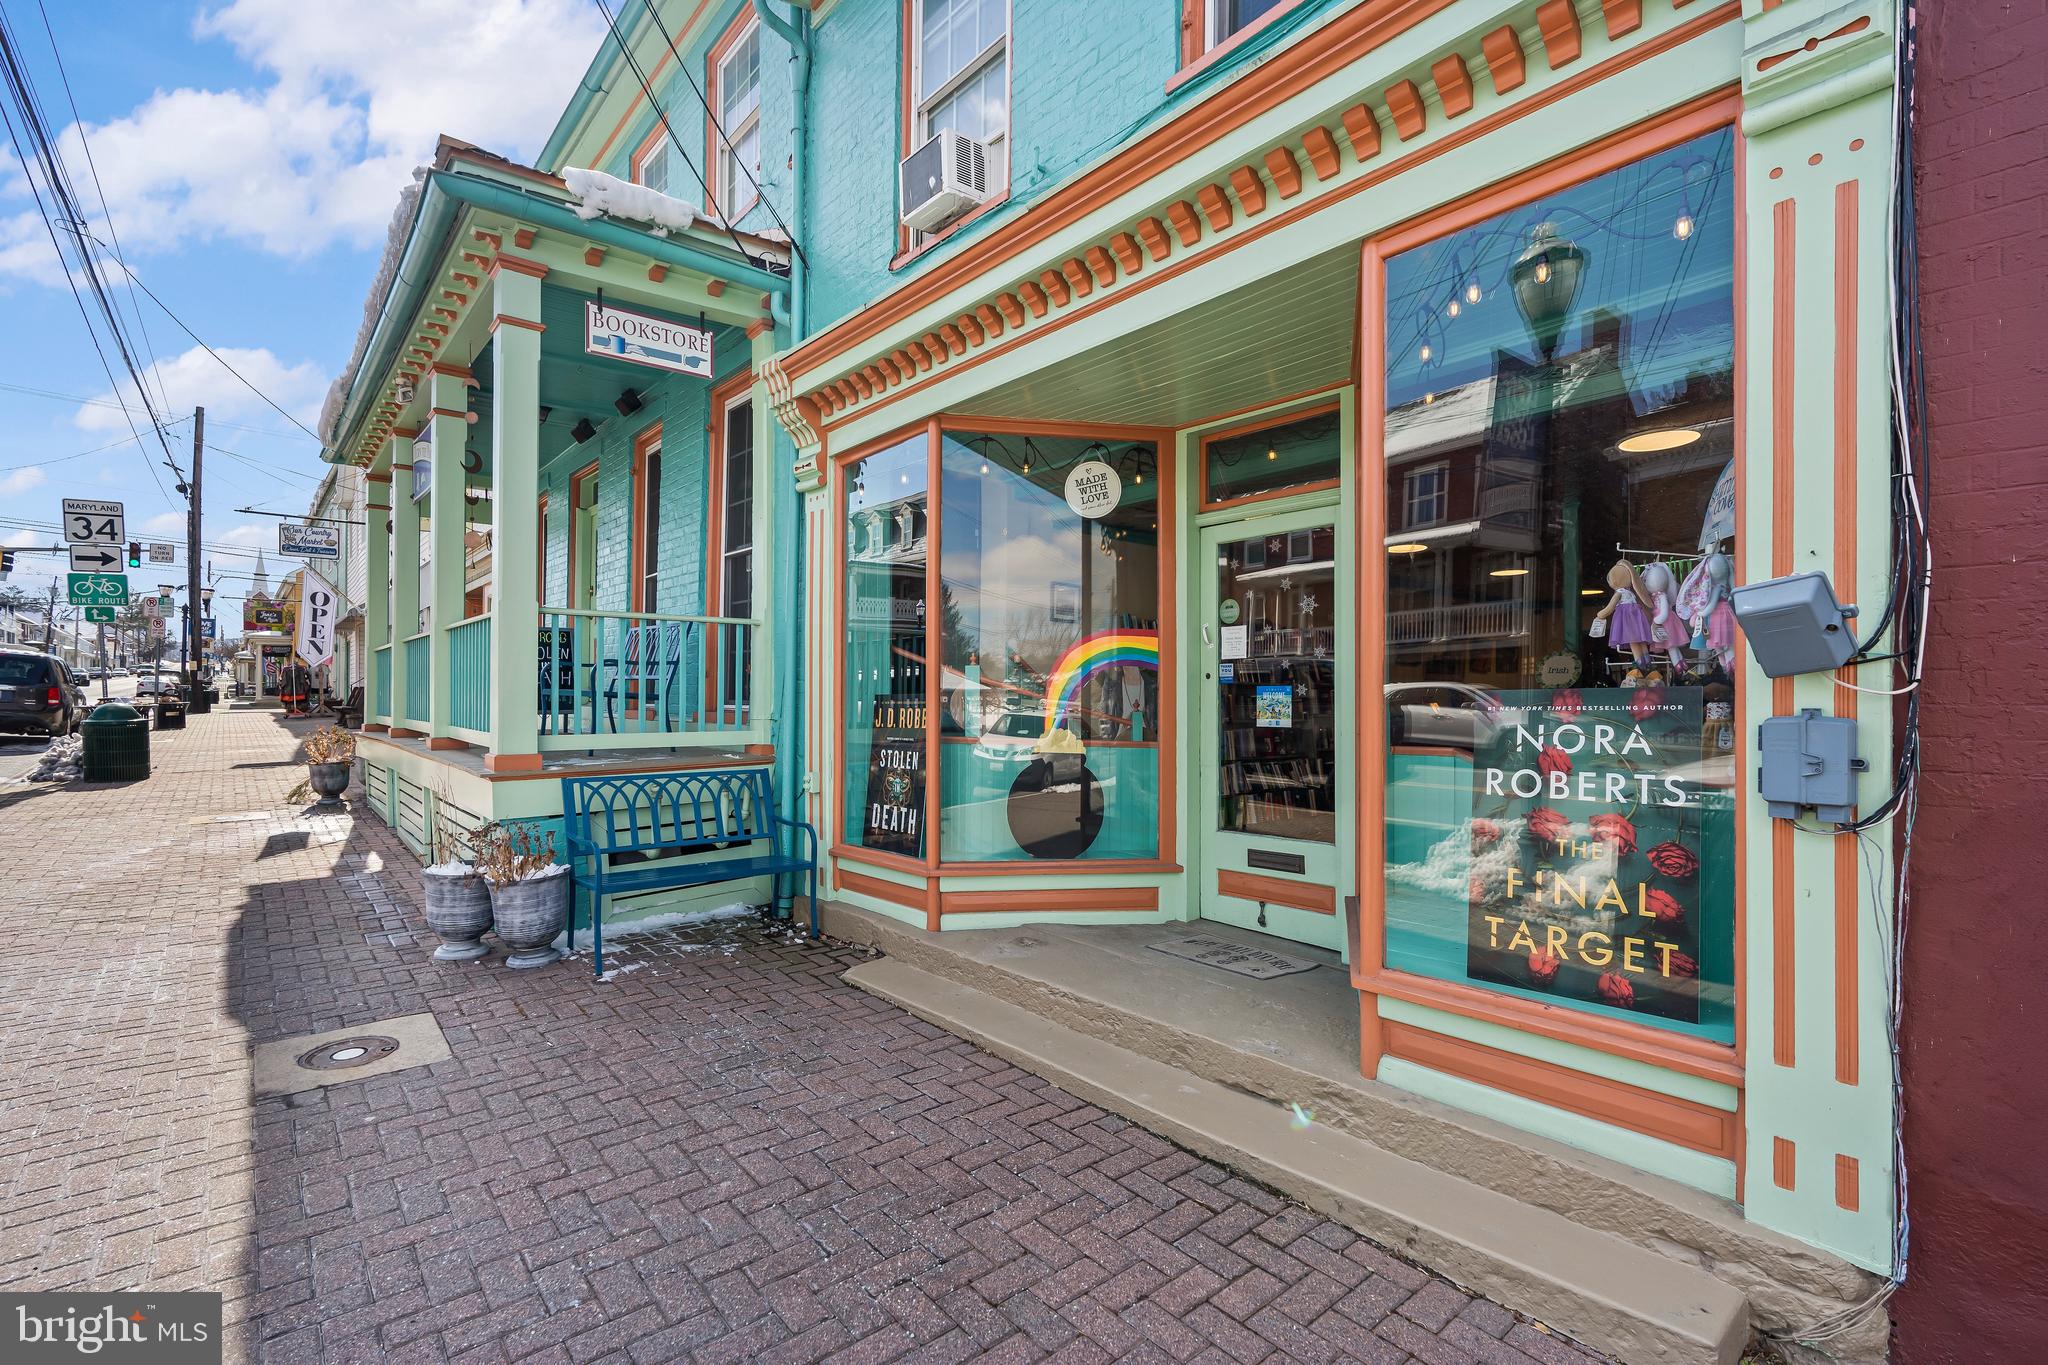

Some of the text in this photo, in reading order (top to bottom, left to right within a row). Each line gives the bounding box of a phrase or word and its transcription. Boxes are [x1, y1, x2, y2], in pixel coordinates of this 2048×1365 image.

[592, 310, 709, 353] BOOKSTORE
[1075, 473, 1108, 487] MADE
[1078, 482, 1108, 496] WITH
[67, 502, 119, 513] MARYLAND
[1081, 491, 1110, 505] LOVE
[72, 516, 118, 541] 34
[304, 527, 332, 539] Country
[296, 535, 324, 546] Market
[72, 596, 127, 605] BIKE ROUTE
[306, 591, 331, 656] OPEN
[1262, 691, 1285, 699] WELCOME
[875, 707, 884, 728] J.
[887, 707, 896, 728] D.
[1515, 723, 1653, 756] NORA
[880, 749, 919, 770] STOLEN
[1485, 768, 1686, 807] ROBERTS
[871, 803, 917, 835] DEATH
[1555, 838, 1604, 860] THE
[1506, 867, 1657, 918] FINAL
[1484, 915, 1679, 977] TARGET
